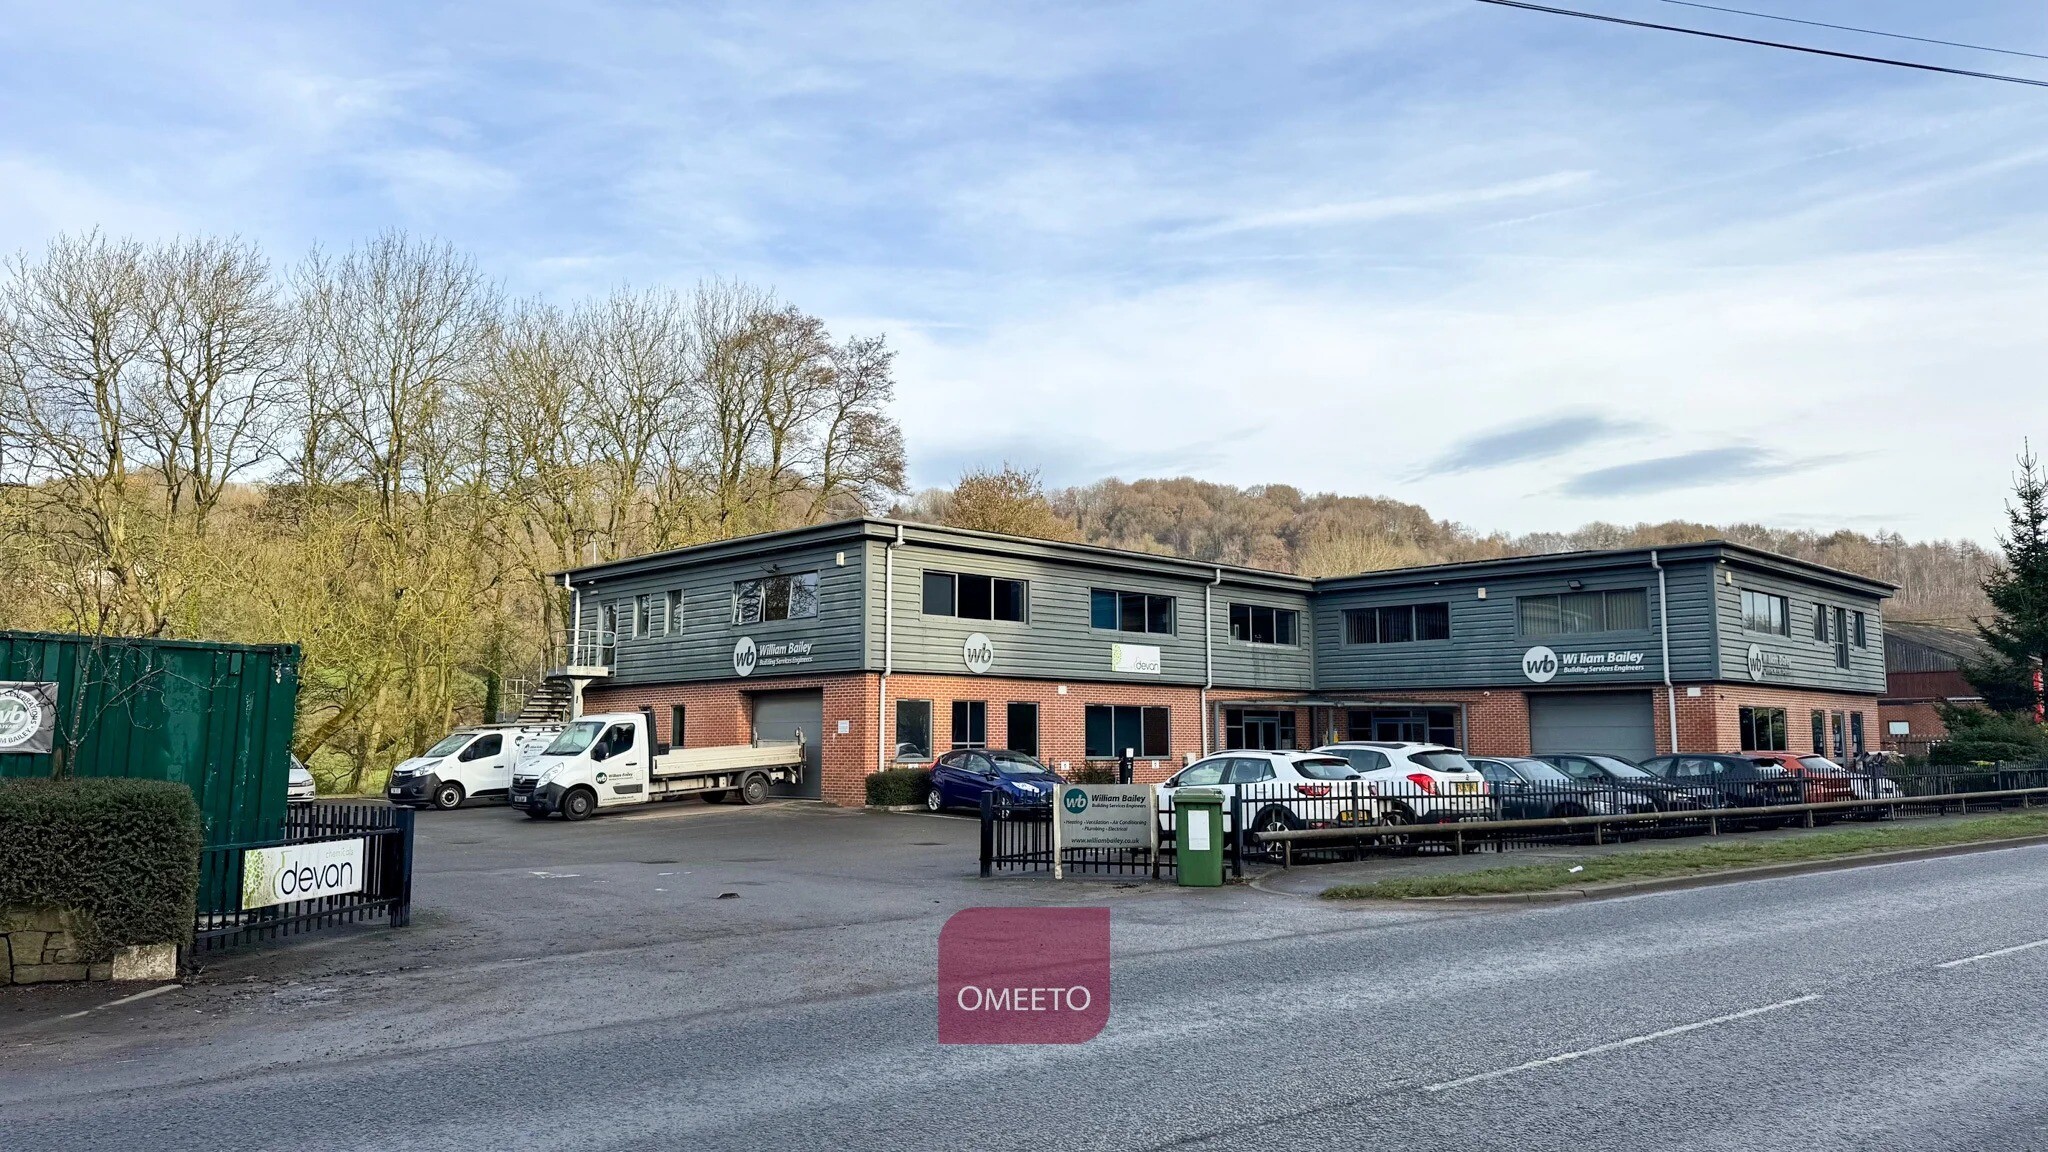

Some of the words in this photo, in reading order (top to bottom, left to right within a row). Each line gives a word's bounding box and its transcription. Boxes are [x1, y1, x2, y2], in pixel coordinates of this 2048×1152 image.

[736, 646, 755, 667] wb
[759, 643, 787, 656] William
[788, 641, 813, 655] Bailey
[967, 642, 991, 663] wb
[1526, 655, 1555, 673] wb
[1607, 651, 1644, 664] Bailey
[1750, 652, 1762, 671] wb
[1614, 664, 1645, 672] Engineers
[8, 728, 31, 744] BAILEY
[1066, 794, 1087, 808] wb
[1091, 794, 1120, 802] William
[1121, 794, 1146, 803] Bailey
[281, 861, 353, 895] devan
